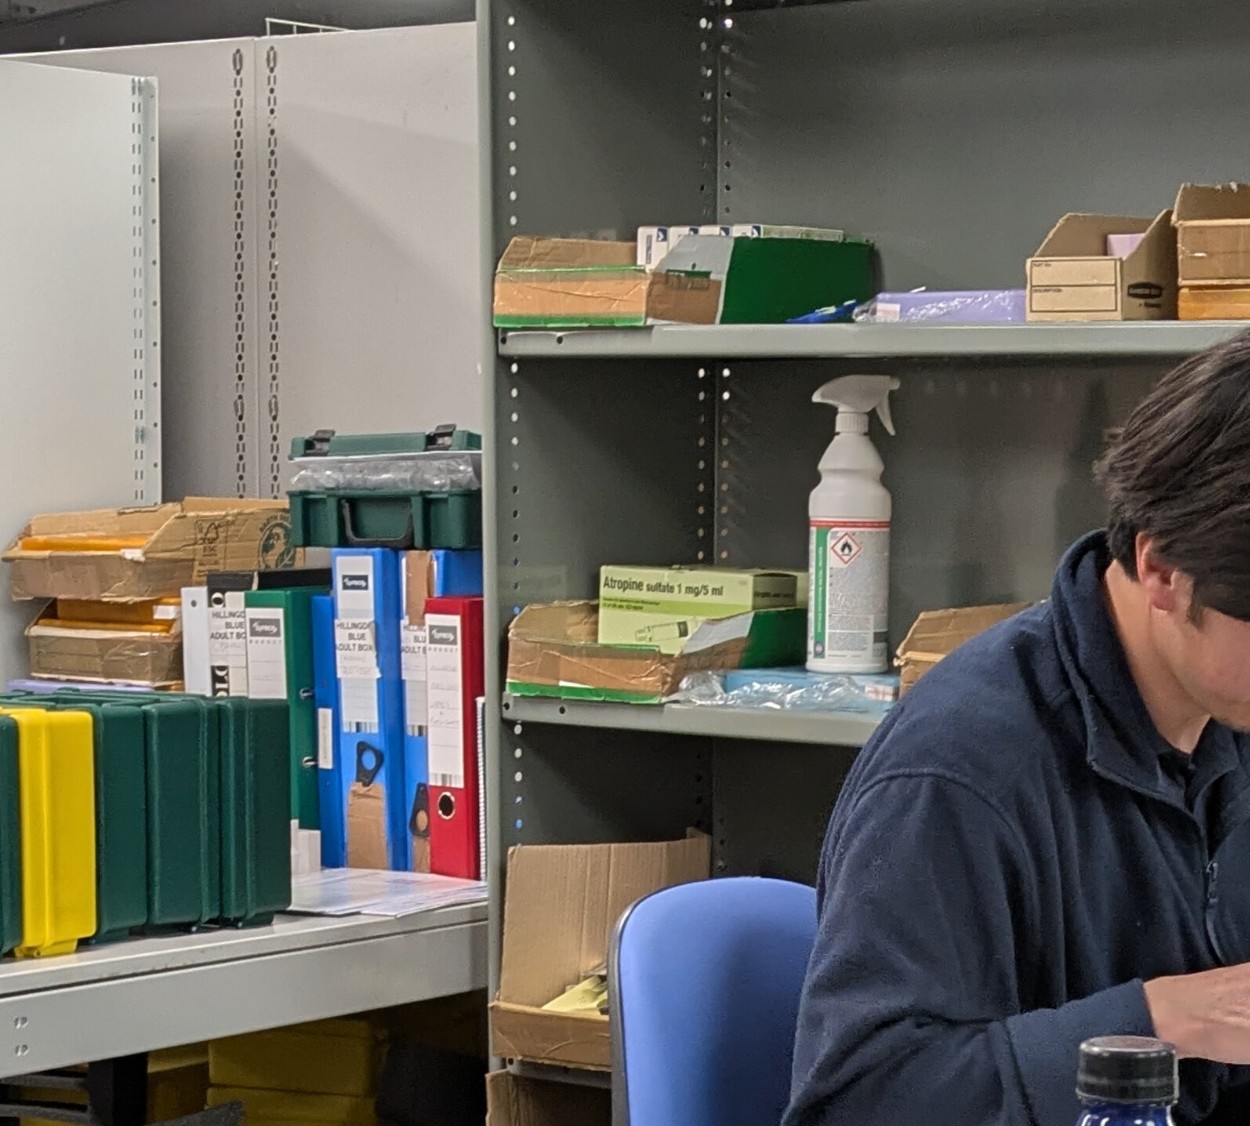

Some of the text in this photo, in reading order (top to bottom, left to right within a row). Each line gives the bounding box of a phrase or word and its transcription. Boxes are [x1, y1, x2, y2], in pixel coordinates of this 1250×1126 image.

[603, 576, 724, 597] Atropine sulfate 1 mg/5 ml
[224, 621, 245, 629] BLUE
[210, 632, 235, 640] ADULT
[348, 633, 367, 641] BLUE
[358, 643, 373, 651] BOX
